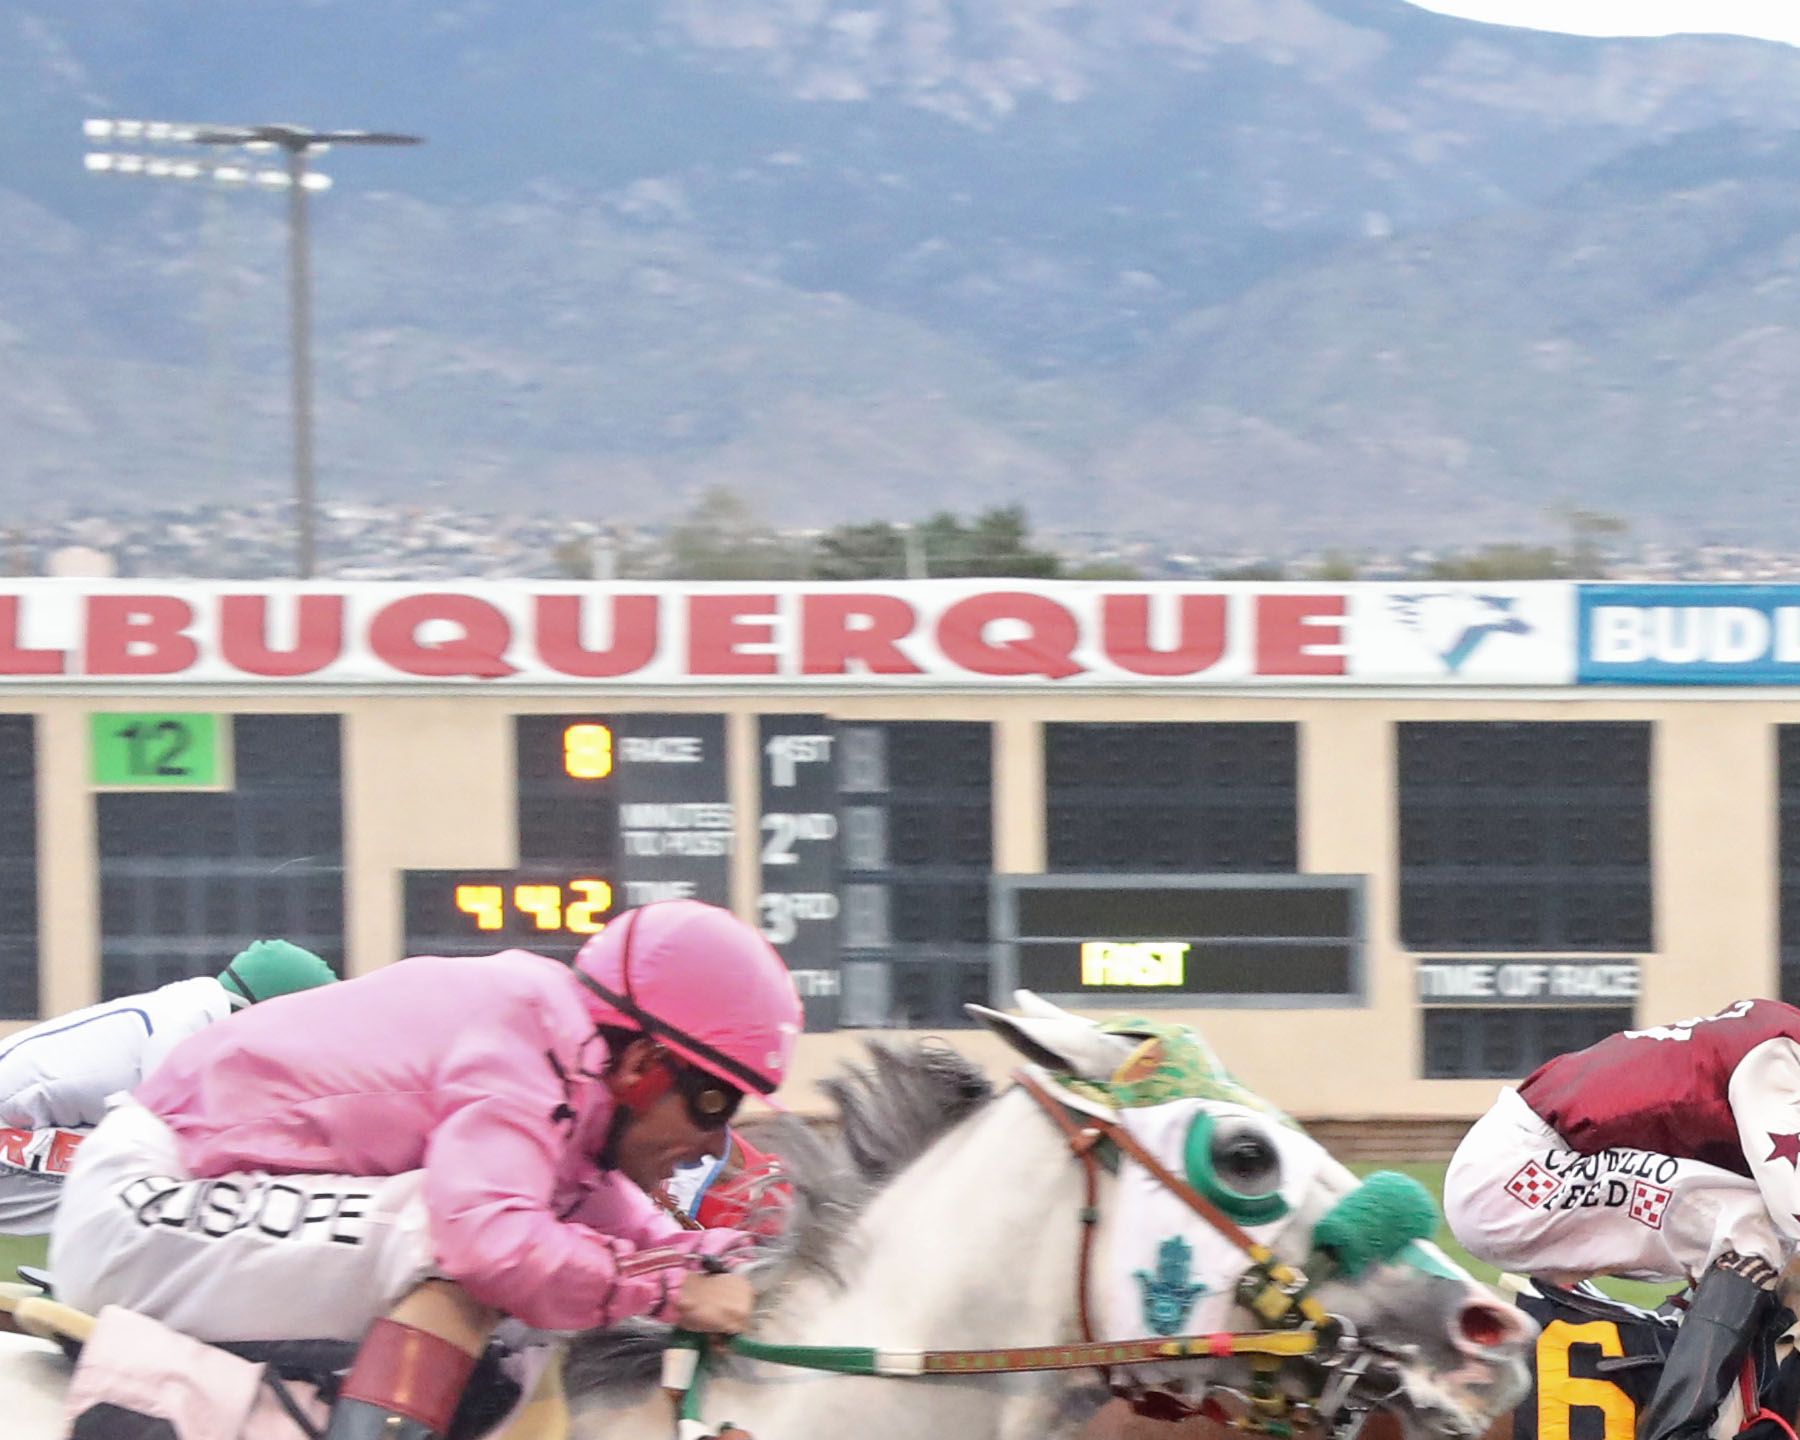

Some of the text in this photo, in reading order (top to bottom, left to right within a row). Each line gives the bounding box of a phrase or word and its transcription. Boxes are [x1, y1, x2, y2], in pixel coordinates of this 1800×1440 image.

[1590, 606, 1770, 663] BUD
[114, 720, 191, 777] 12
[563, 723, 612, 779] 8
[619, 736, 704, 762] RACE
[1417, 964, 1642, 996] TIME OF RACE
